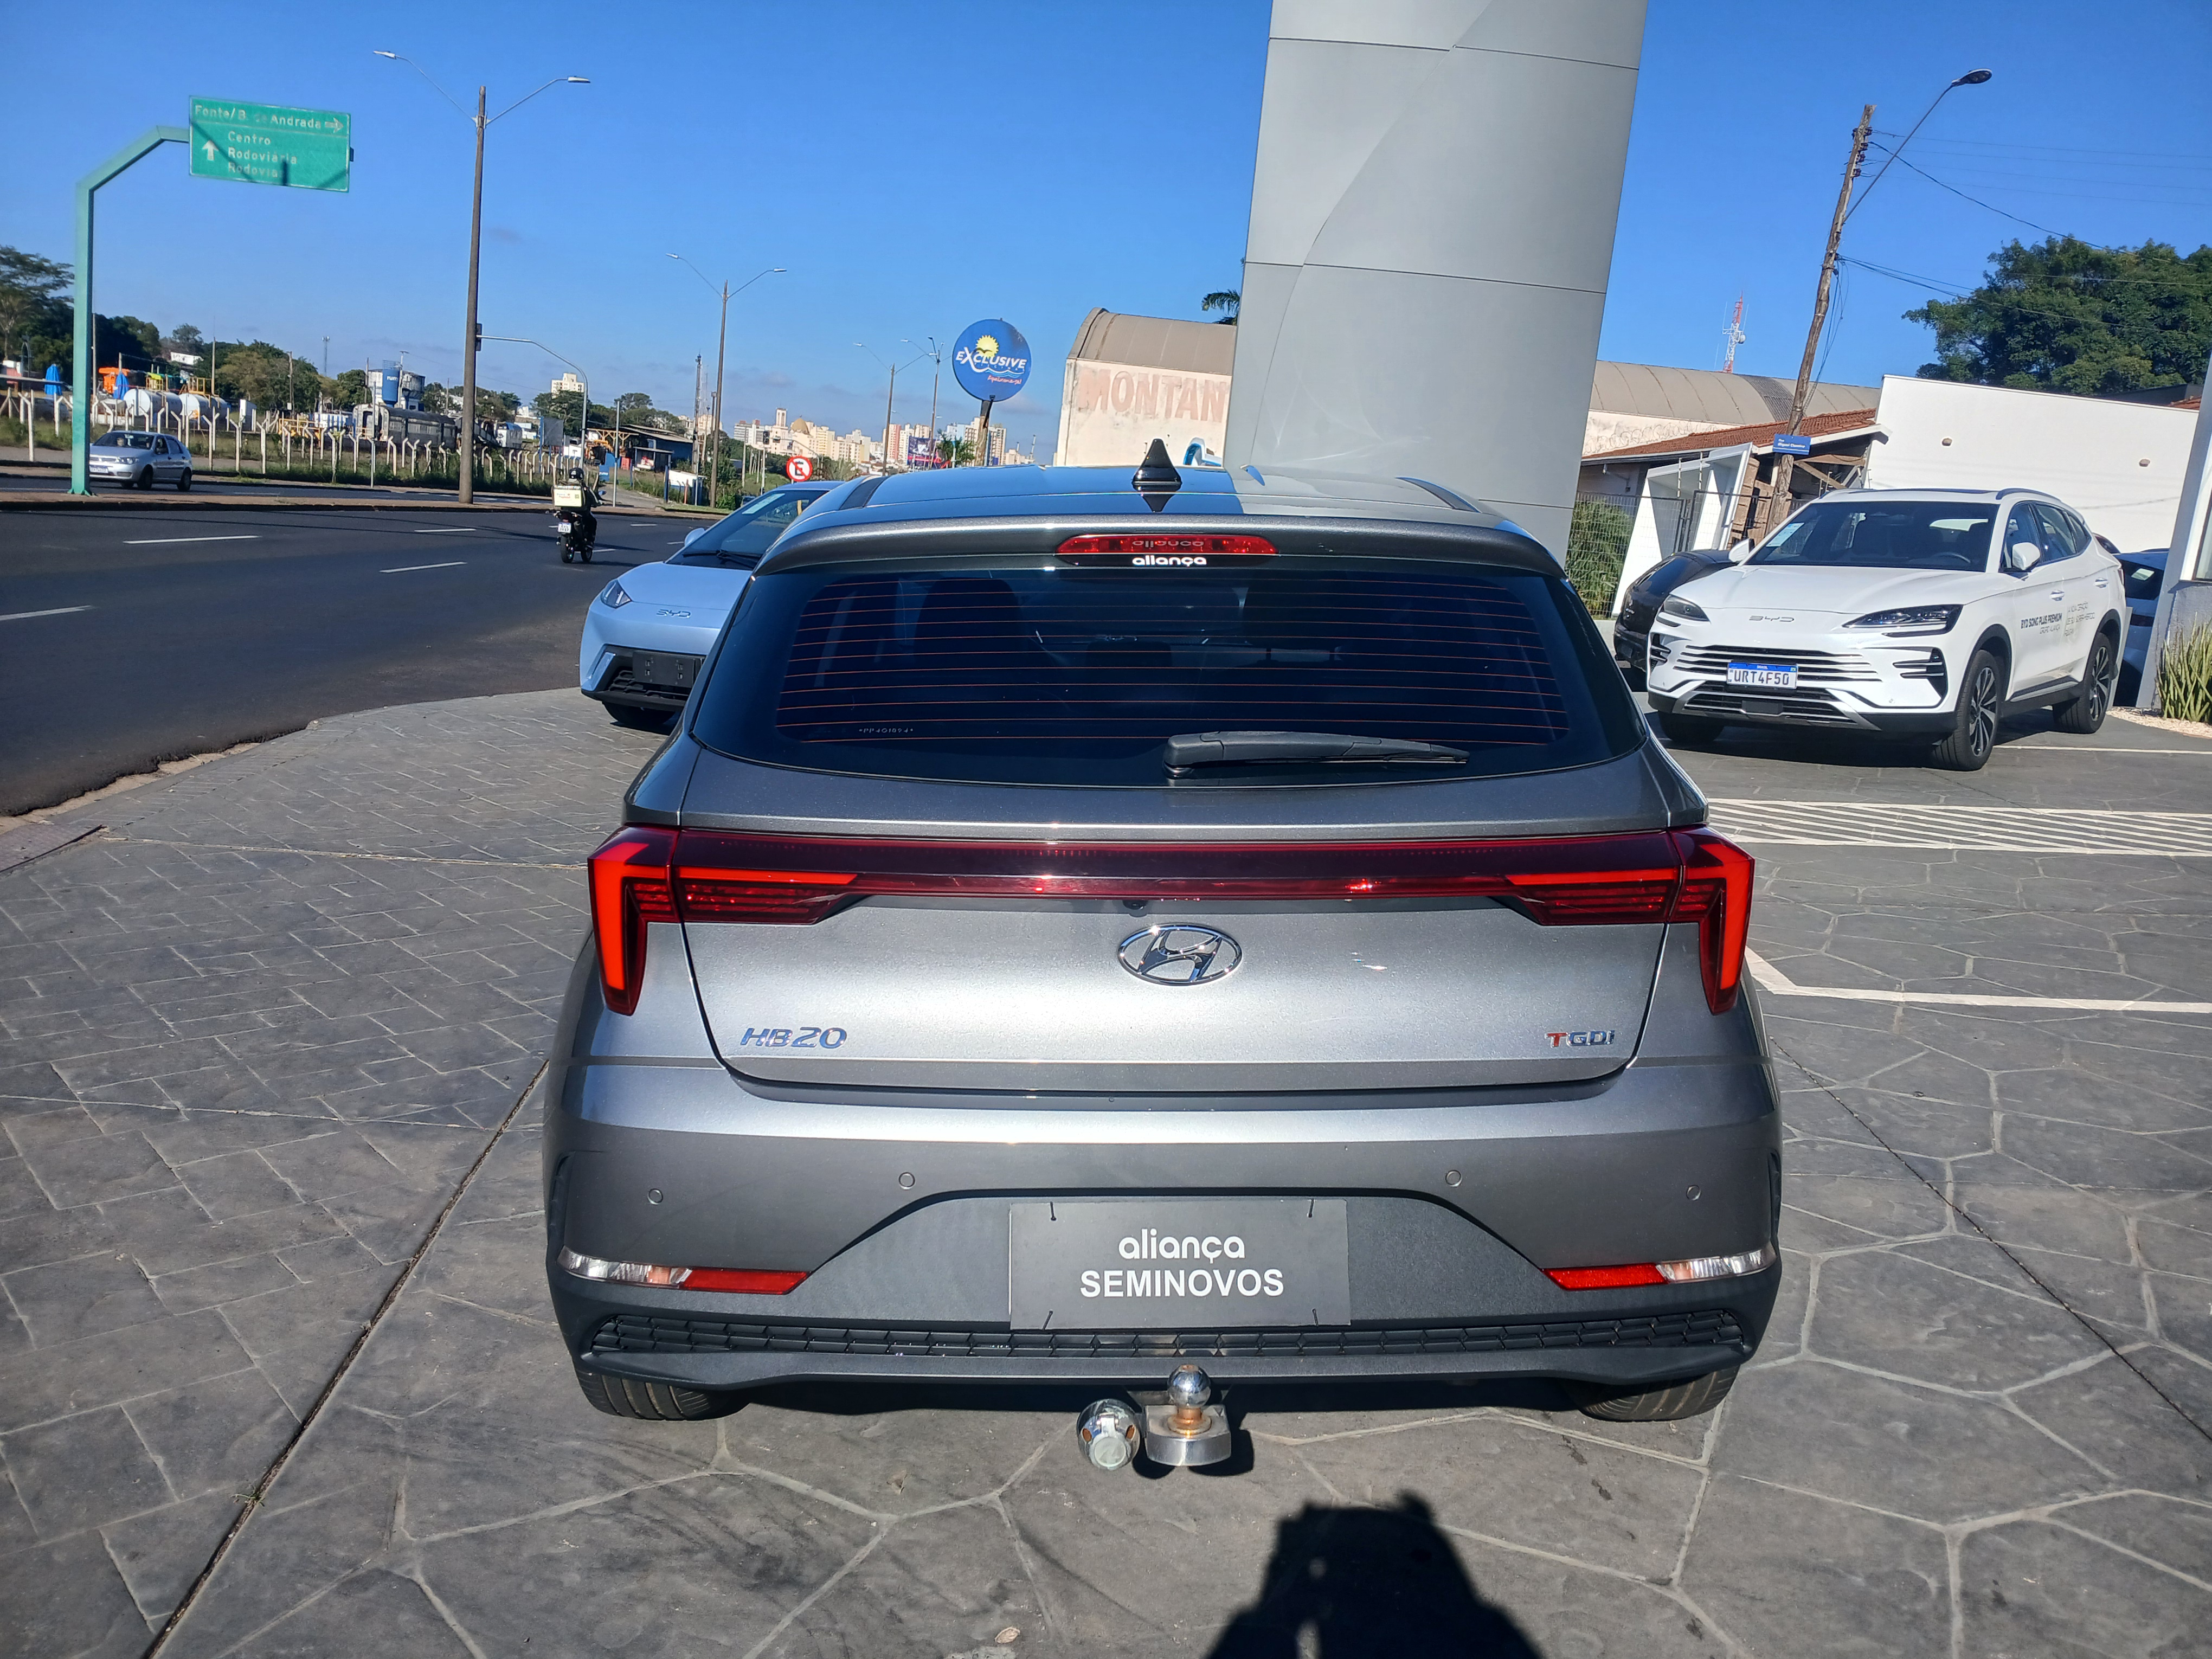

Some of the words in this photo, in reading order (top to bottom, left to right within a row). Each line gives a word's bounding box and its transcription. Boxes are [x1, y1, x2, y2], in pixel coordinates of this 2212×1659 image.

[270, 114, 321, 130] Andrada
[228, 130, 272, 145] Centro
[955, 346, 1027, 370] EXCLUSIVE
[1078, 367, 1227, 423] MONTAN
[1132, 555, 1207, 568] aliança
[655, 608, 692, 619] BYD
[1748, 615, 1795, 623] BYD
[1734, 670, 1790, 685] URT4F50
[740, 1027, 847, 1049] HB20
[1118, 1227, 1245, 1264] aliança
[1080, 1269, 1284, 1298] SEMINOVOS
